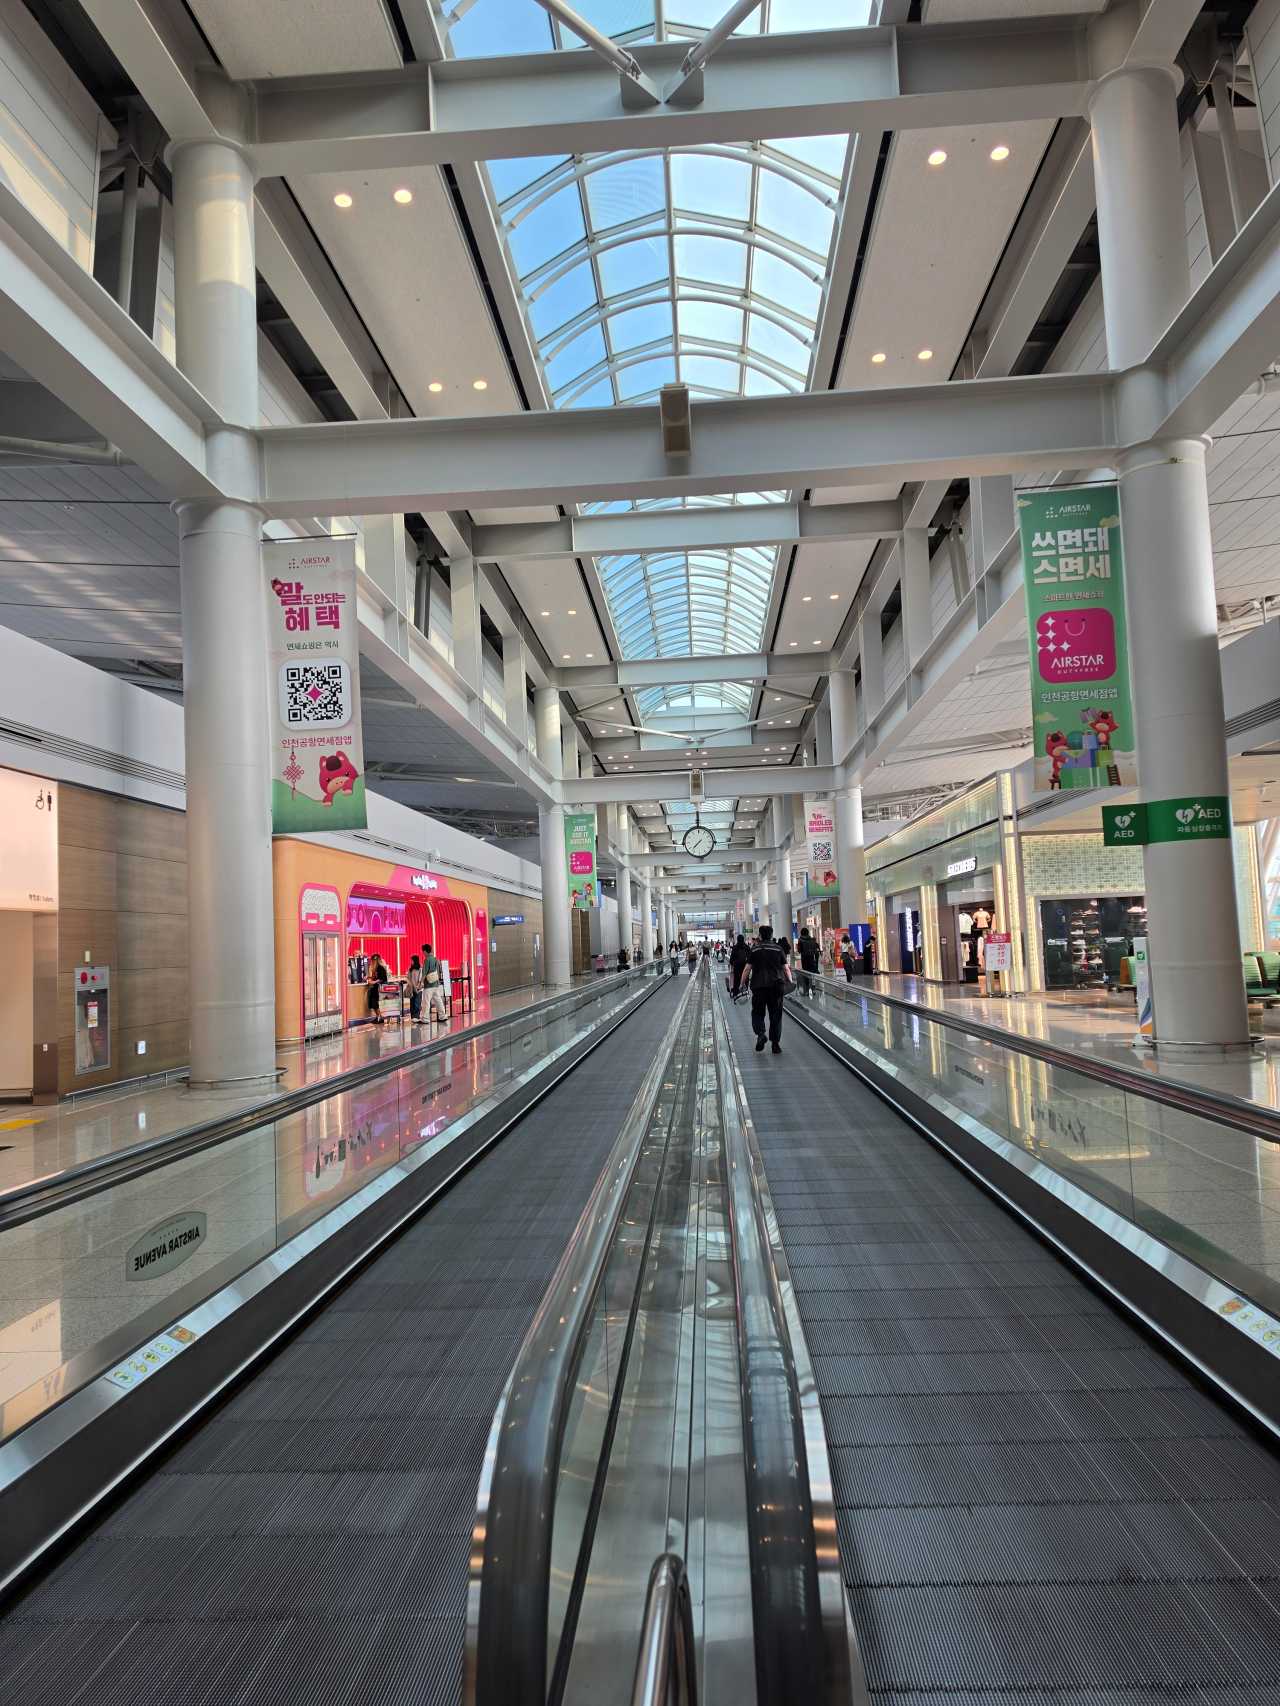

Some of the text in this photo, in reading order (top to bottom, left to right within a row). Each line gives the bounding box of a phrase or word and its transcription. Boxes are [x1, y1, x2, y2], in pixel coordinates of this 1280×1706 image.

[1059, 504, 1091, 514] AIRSTAR
[1031, 527, 1110, 557] 쓰면돼
[301, 555, 331, 566] AIRSTAR
[1033, 554, 1111, 584] 스면세
[1050, 654, 1105, 670] AIRSTAR
[1198, 808, 1222, 820] AED
[1113, 829, 1135, 839] AED
